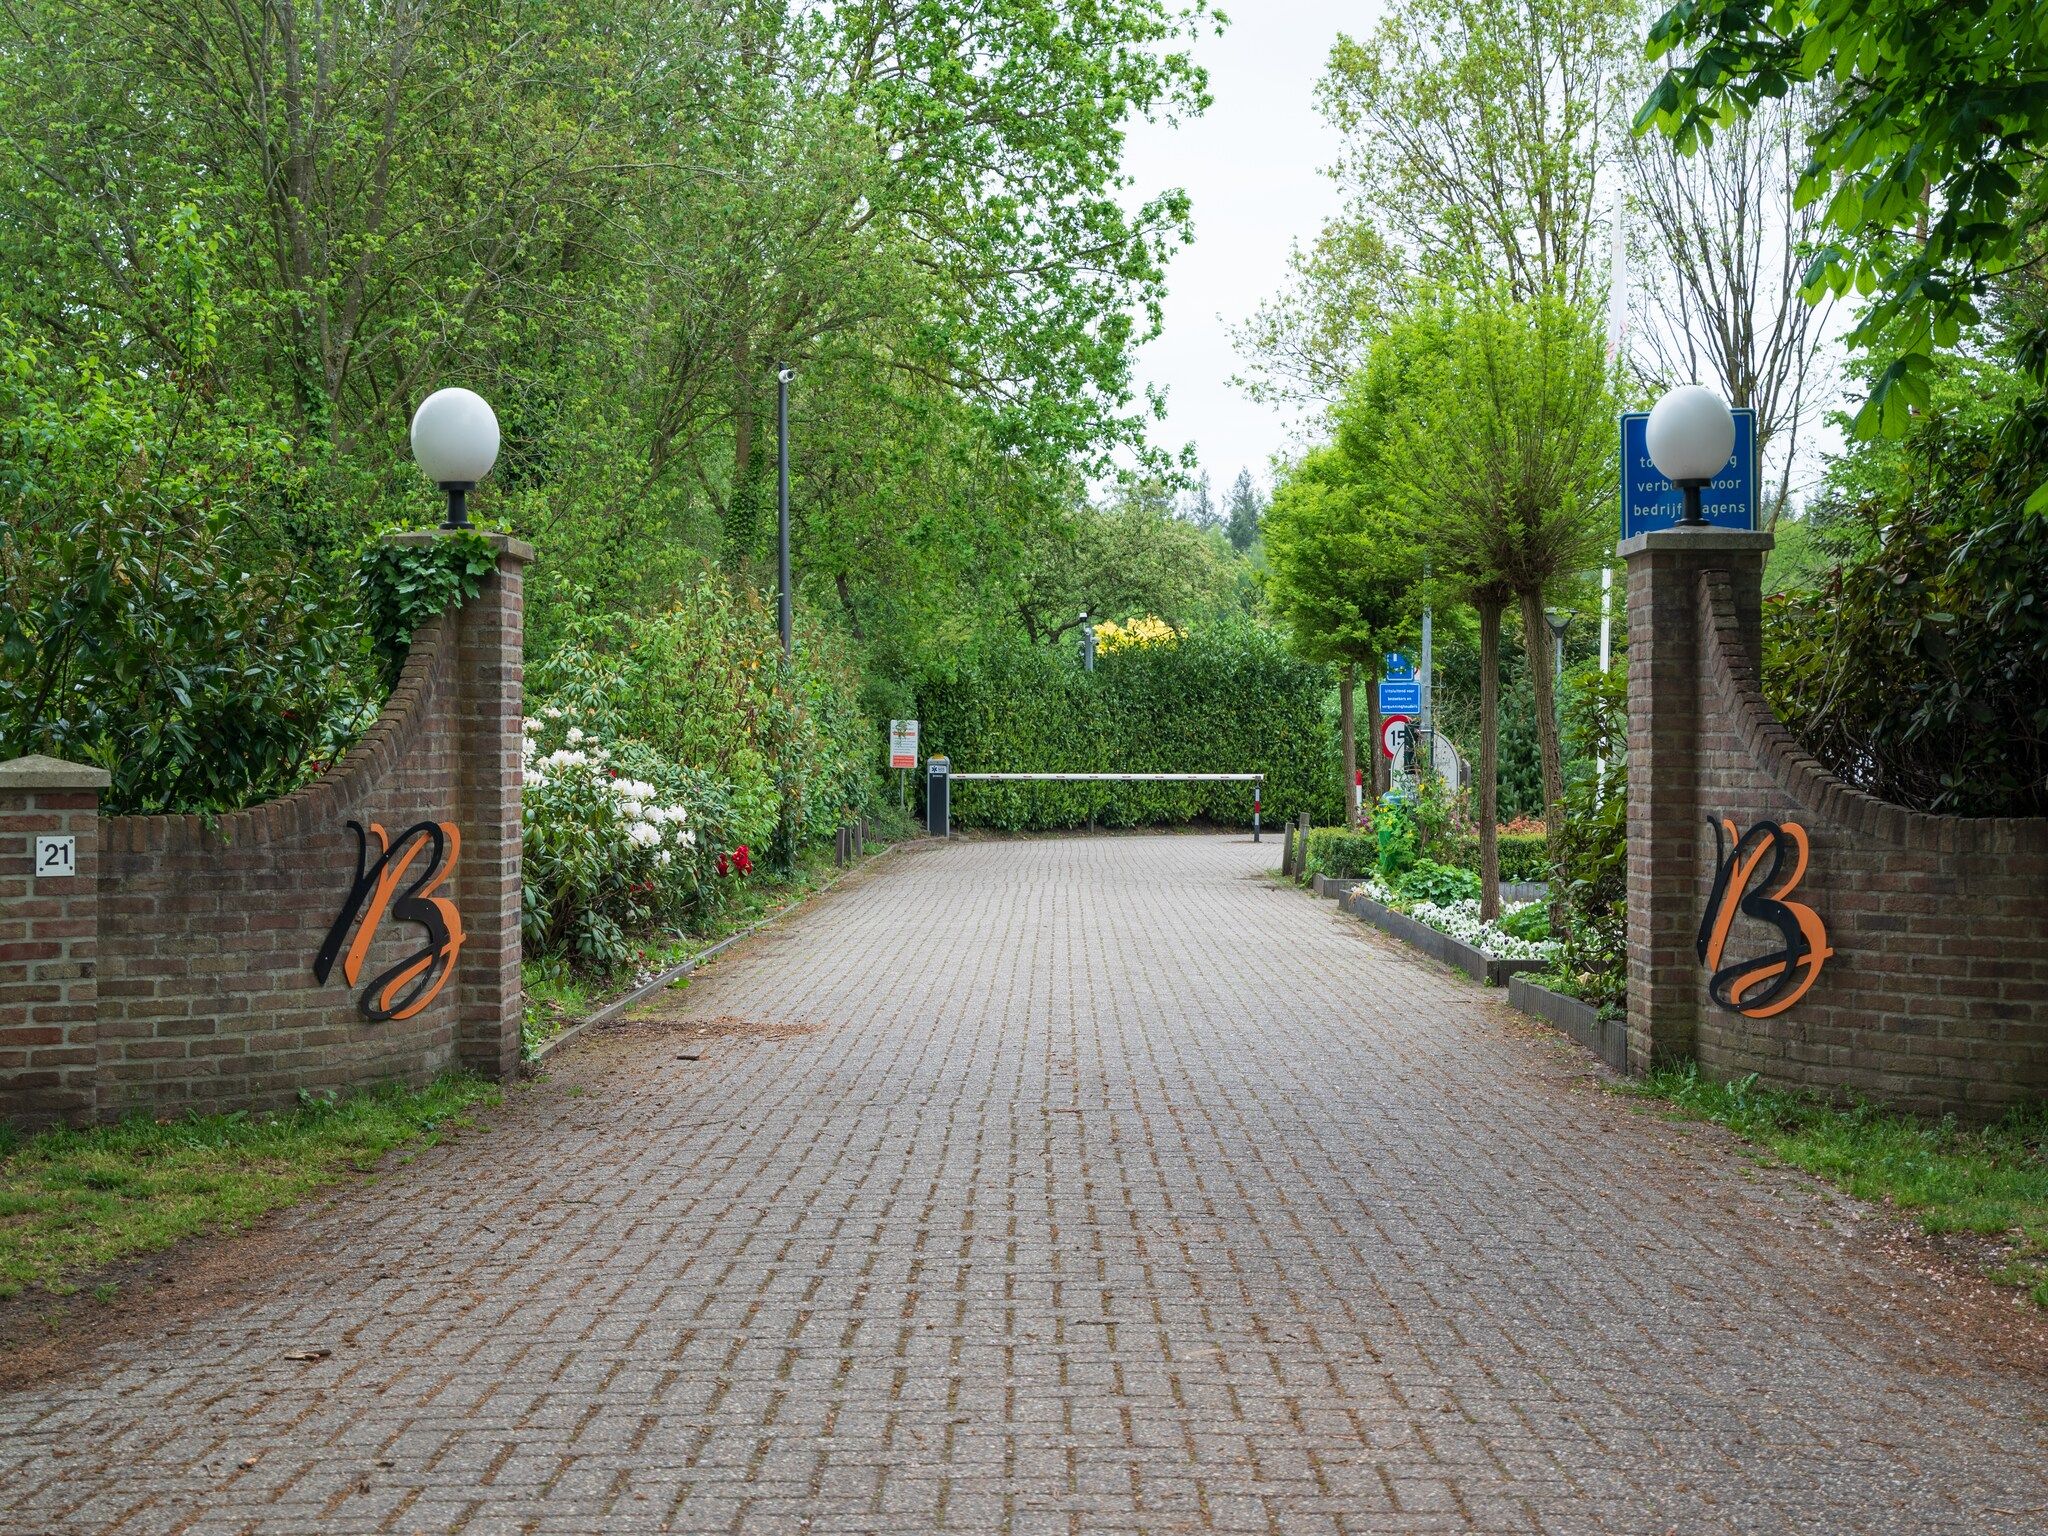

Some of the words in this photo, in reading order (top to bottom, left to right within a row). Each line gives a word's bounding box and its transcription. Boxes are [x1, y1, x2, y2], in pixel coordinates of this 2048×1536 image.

[1710, 480, 1741, 490] voor
[1634, 502, 1746, 519] bedrijfagens
[45, 843, 68, 865] 21
